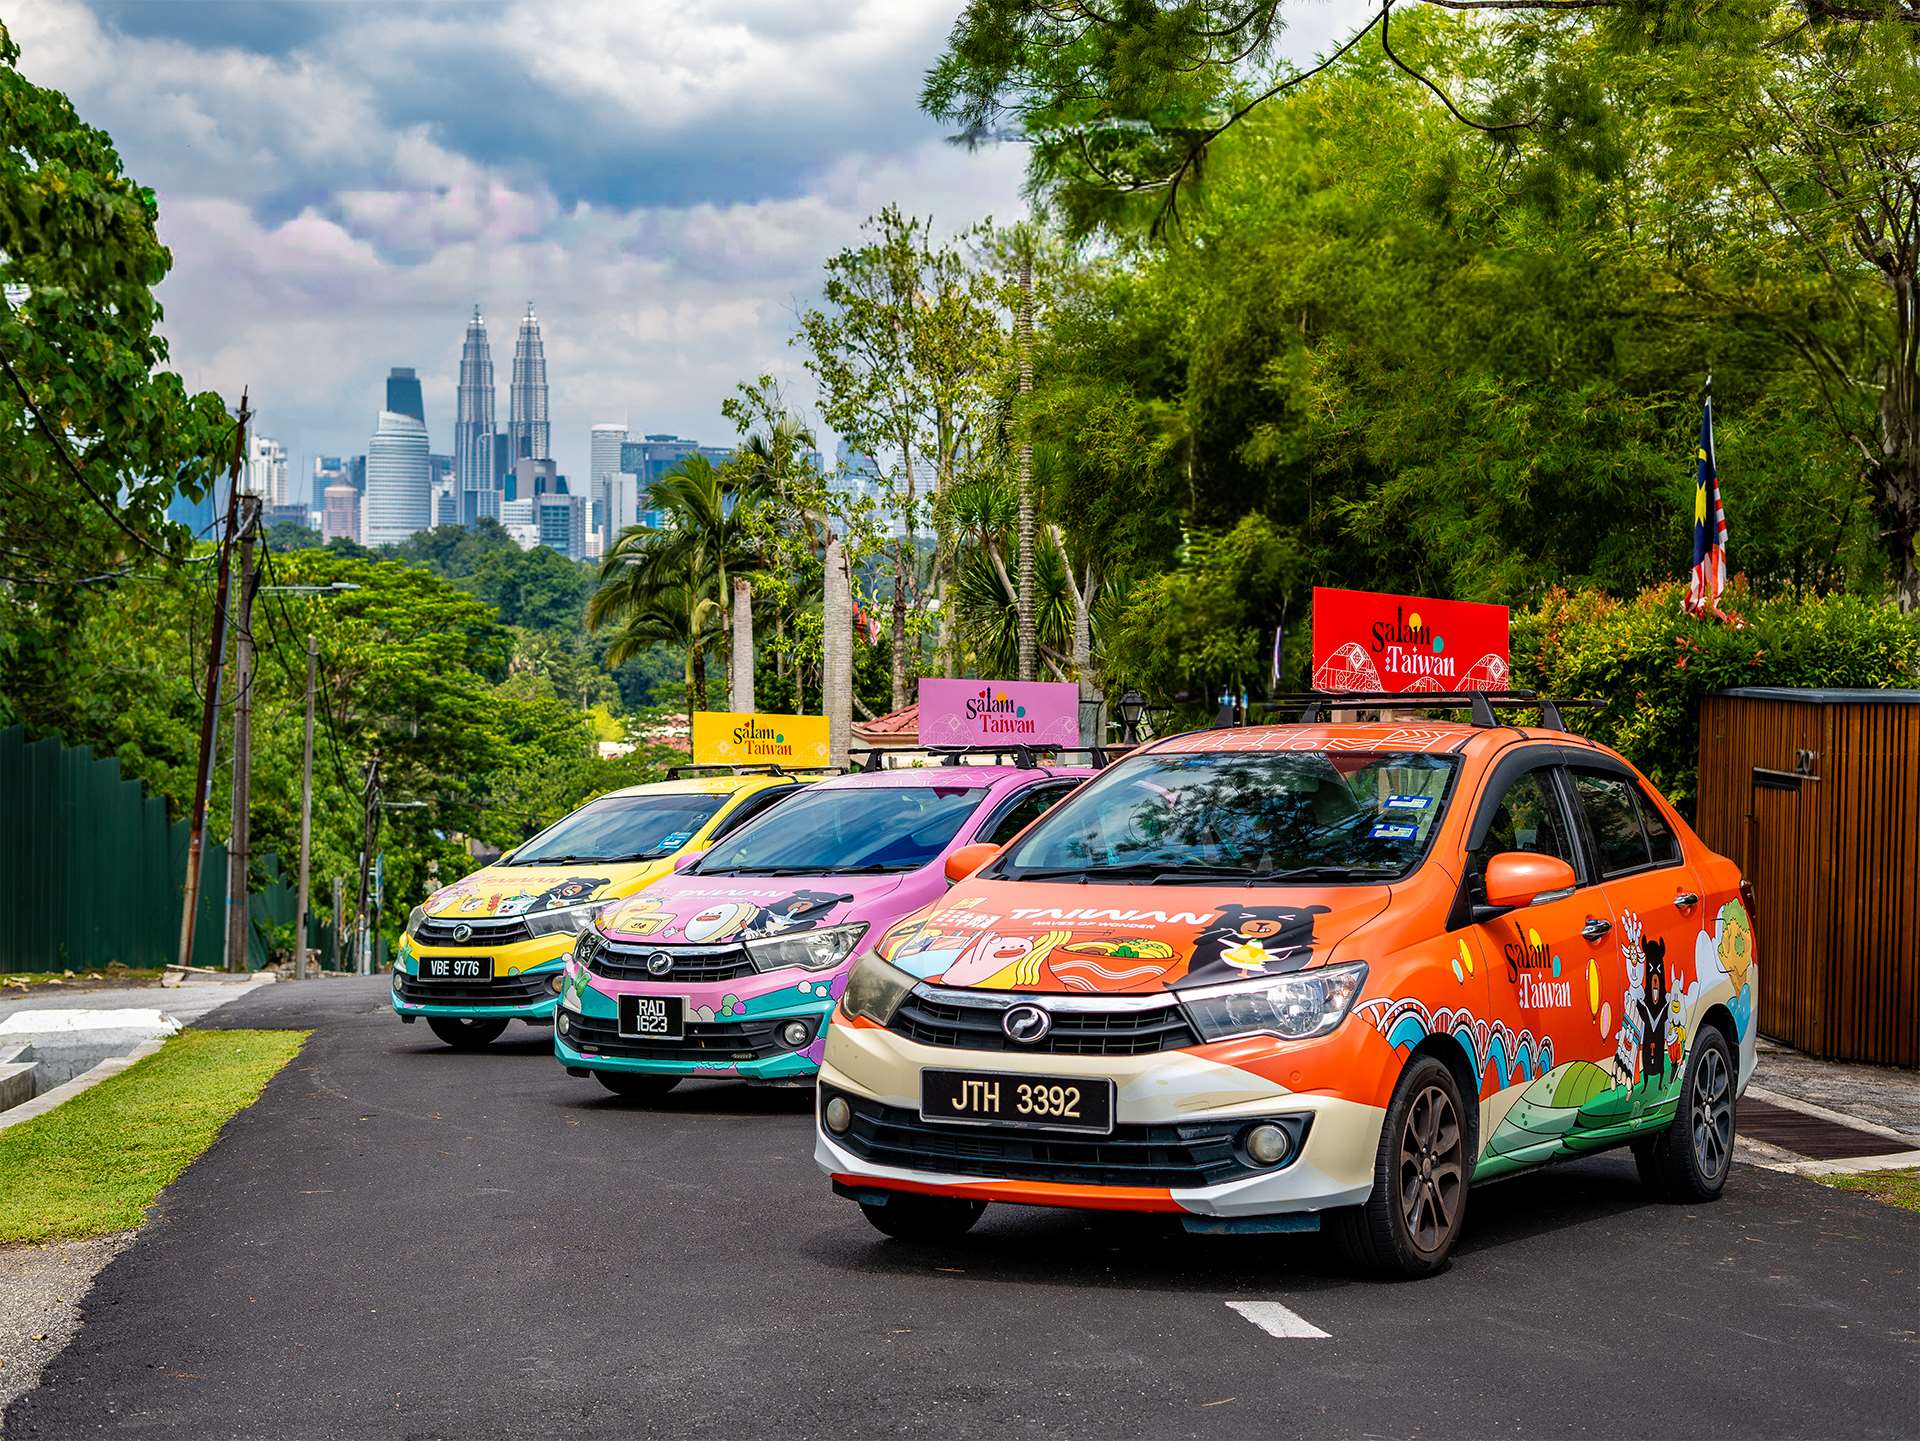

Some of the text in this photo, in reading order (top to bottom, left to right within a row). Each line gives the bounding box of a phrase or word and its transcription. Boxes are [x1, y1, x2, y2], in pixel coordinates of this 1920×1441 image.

[1371, 605, 1431, 652] Salam
[1386, 645, 1455, 677] Taiwan
[965, 687, 1015, 720] Salam
[733, 718, 775, 744] Salam
[979, 714, 1036, 734] Taiwan
[745, 739, 792, 756] Taiwan
[1010, 908, 1214, 925] TAIWAN
[1098, 921, 1157, 929] WONDER
[1504, 920, 1552, 984] Salam
[431, 960, 480, 976] VBE 9776
[1519, 972, 1572, 1009] Taiwan
[638, 999, 666, 1016] RAD
[637, 1016, 668, 1033] 1623
[951, 1080, 1081, 1118] JTH 3392
